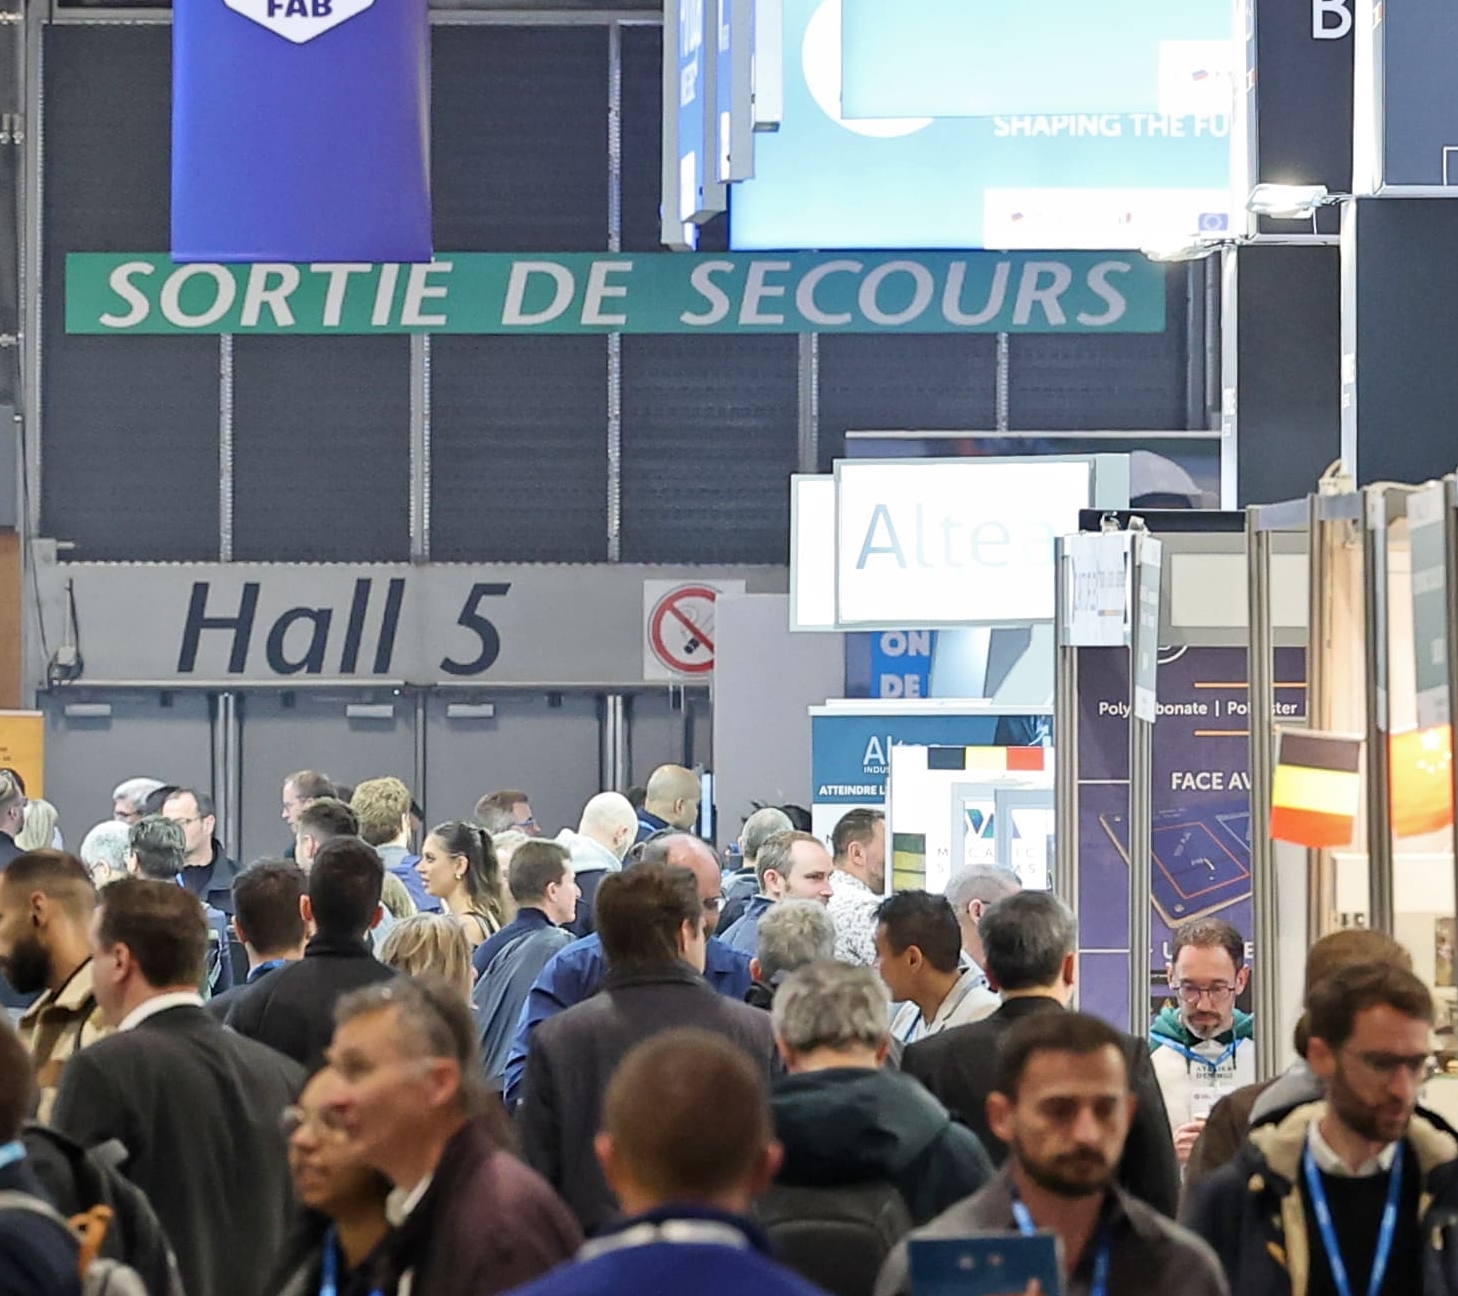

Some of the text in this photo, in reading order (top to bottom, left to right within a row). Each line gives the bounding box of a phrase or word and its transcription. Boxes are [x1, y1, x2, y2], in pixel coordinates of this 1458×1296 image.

[993, 113, 1121, 138] SHAPING
[1132, 113, 1186, 137] THE
[100, 259, 1132, 327] SORTIE DE SECOURS
[177, 577, 512, 676] Hall 5
[1099, 701, 1208, 719] Polybonate
[819, 785, 877, 796] ATTEINDRE
[1172, 772, 1223, 790] FACE
